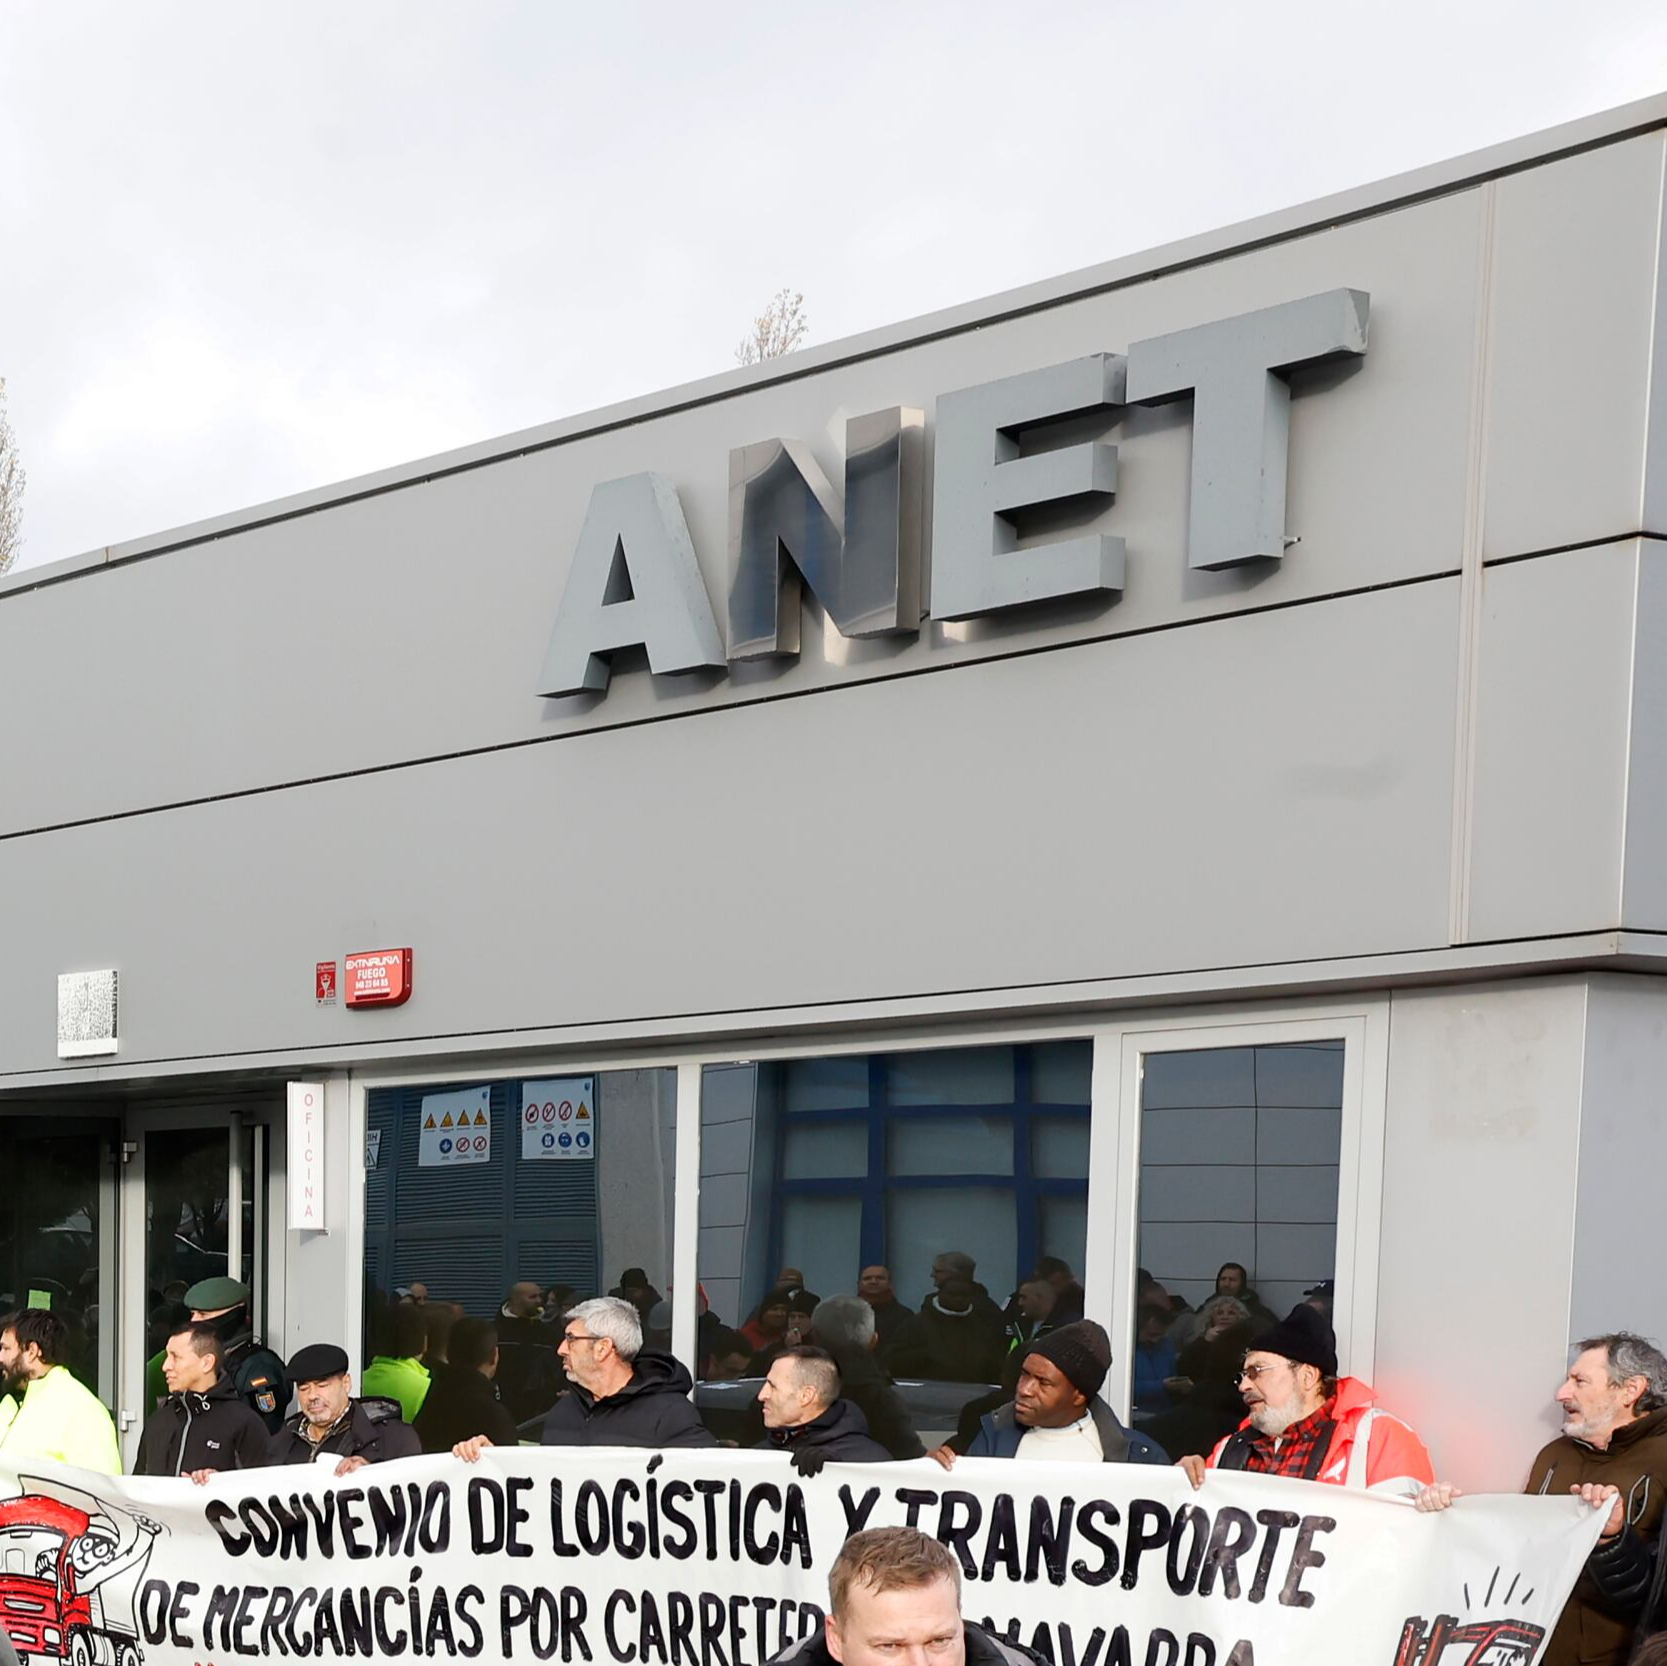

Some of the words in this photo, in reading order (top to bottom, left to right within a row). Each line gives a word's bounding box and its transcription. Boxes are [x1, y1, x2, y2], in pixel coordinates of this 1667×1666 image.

[535, 287, 1371, 698] ANET
[357, 967, 385, 980] FUEGO
[304, 1093, 314, 1218] OFICINA
[205, 1480, 451, 1561] CONVENIO
[468, 1476, 534, 1558] DE
[550, 1453, 813, 1570] LOGÍSTICA
[838, 1483, 881, 1540] Y
[140, 1579, 201, 1649] DE
[202, 1566, 485, 1658] MERCANCÍAS
[501, 1584, 594, 1663] POR
